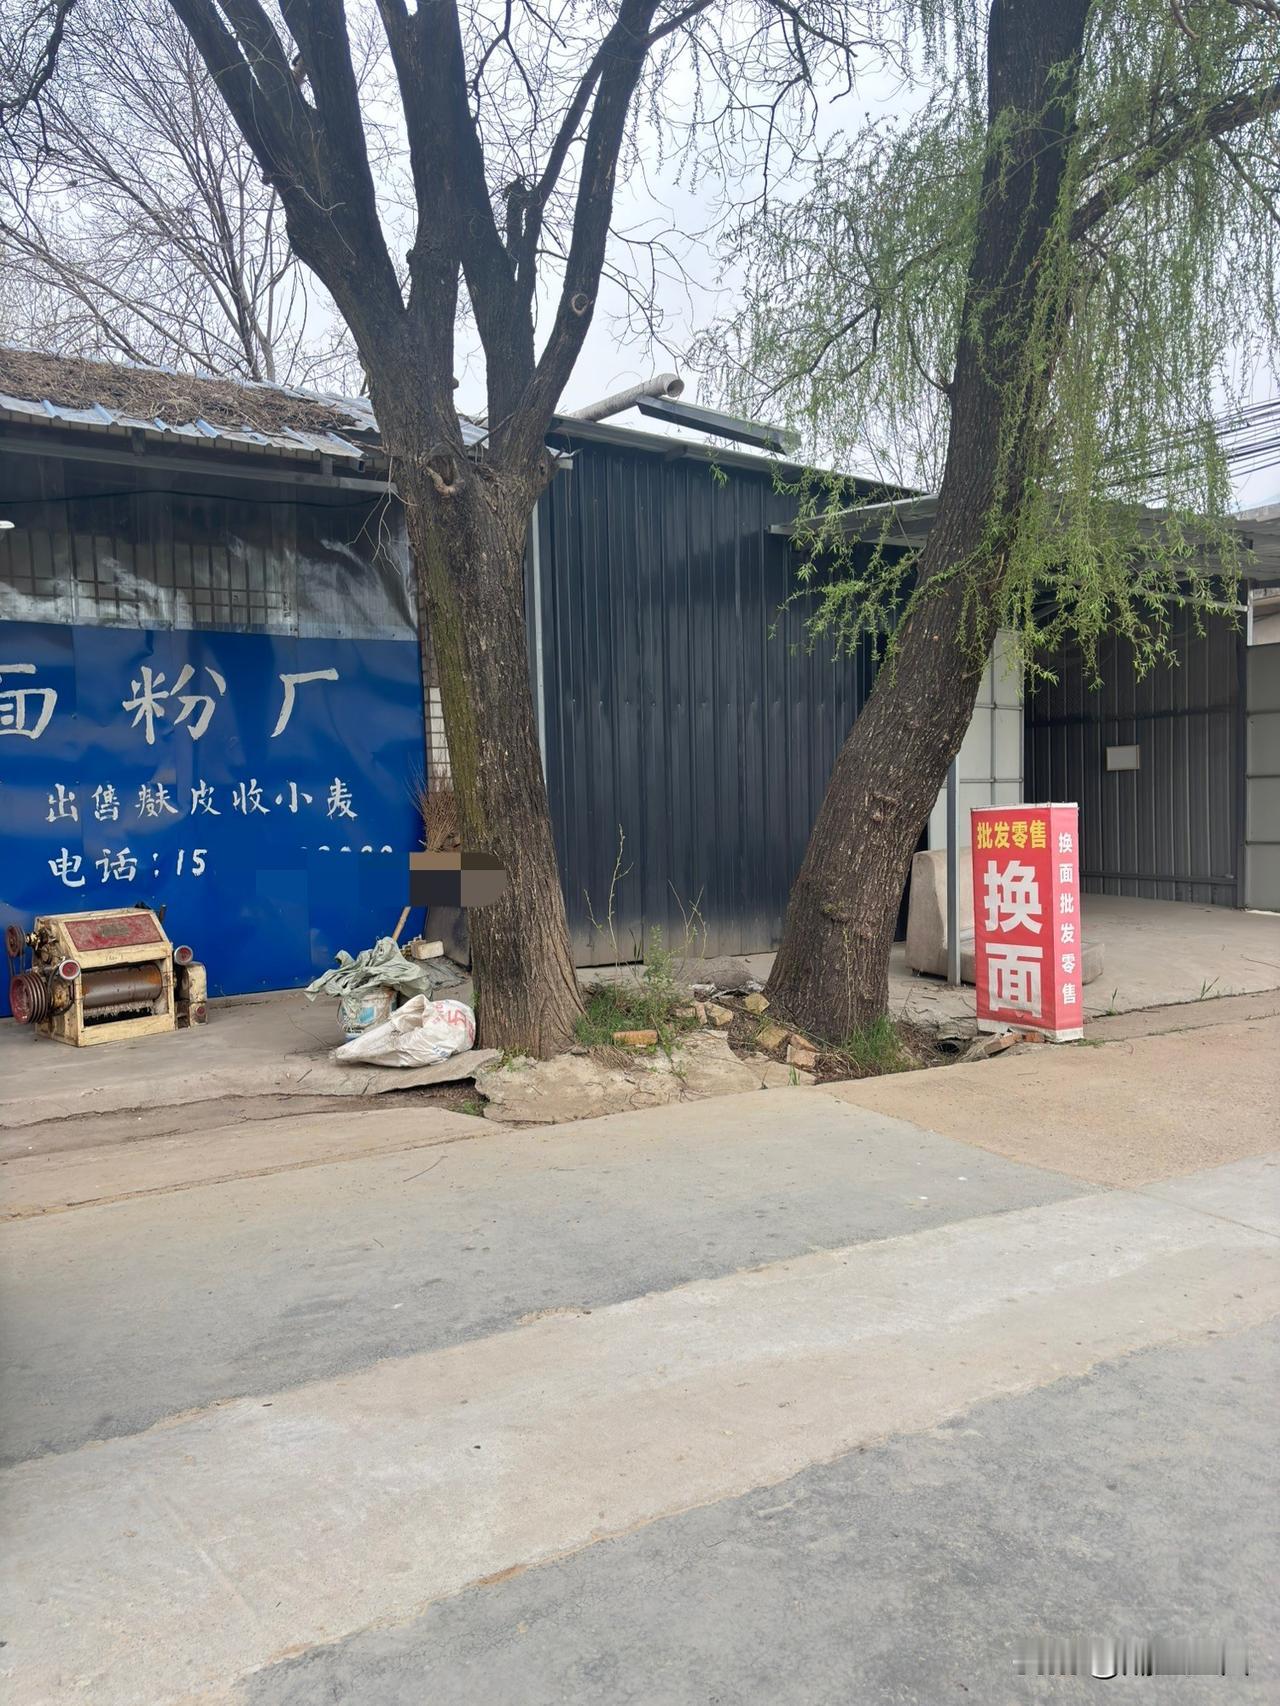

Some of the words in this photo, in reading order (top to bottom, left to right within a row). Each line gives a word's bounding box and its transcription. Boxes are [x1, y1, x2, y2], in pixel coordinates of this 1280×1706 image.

[976, 819, 1047, 850] 批发零售
[983, 859, 1044, 1018] 换面
[1058, 832, 1076, 1005] 换面批发零售
